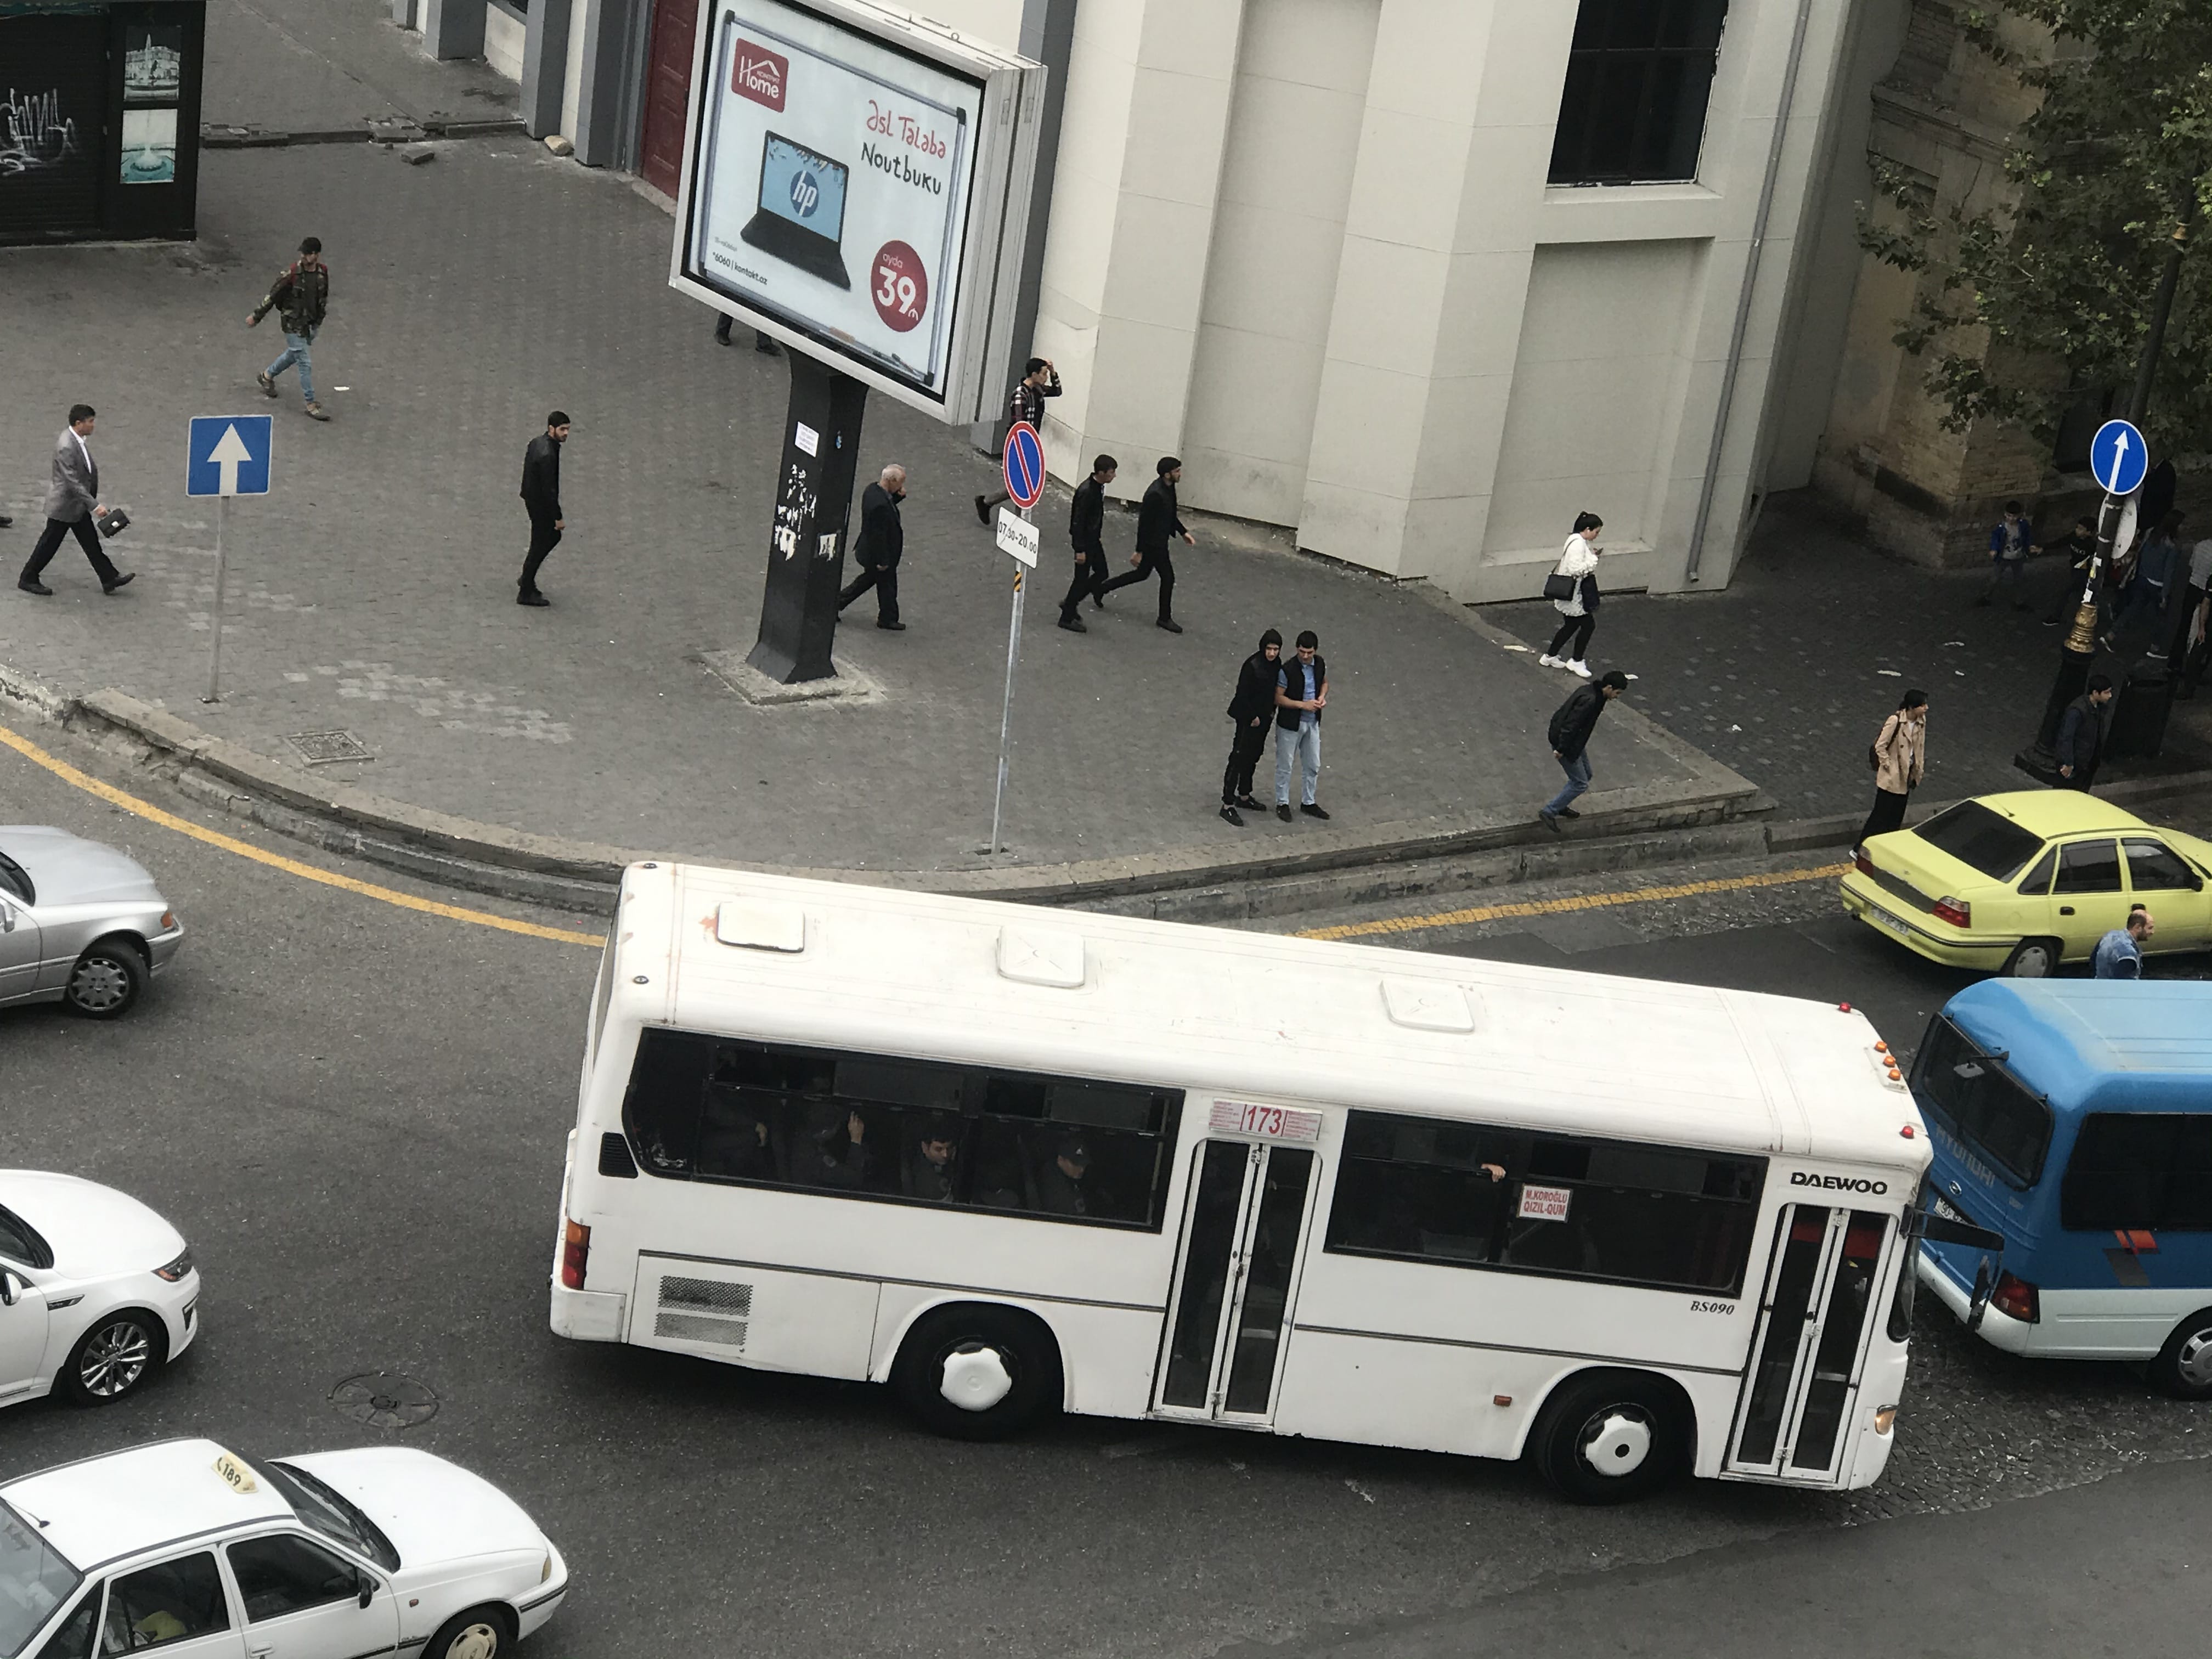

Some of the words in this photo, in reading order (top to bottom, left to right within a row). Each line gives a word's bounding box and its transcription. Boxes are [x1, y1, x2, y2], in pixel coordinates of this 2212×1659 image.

[738, 55, 780, 98] Home
[861, 142, 941, 195] Noutbuku
[792, 170, 817, 216] hp
[883, 253, 903, 268] ayda
[735, 262, 768, 285] kontakt.az
[1248, 1106, 1282, 1134] 173
[1936, 1125, 1996, 1188] HYUNDAI
[1790, 1172, 1888, 1195] DAEWOO
[1523, 1201, 1565, 1216] QIZIL-QUM
[1690, 1301, 1735, 1315] BS090
[223, 1463, 241, 1486] 189
